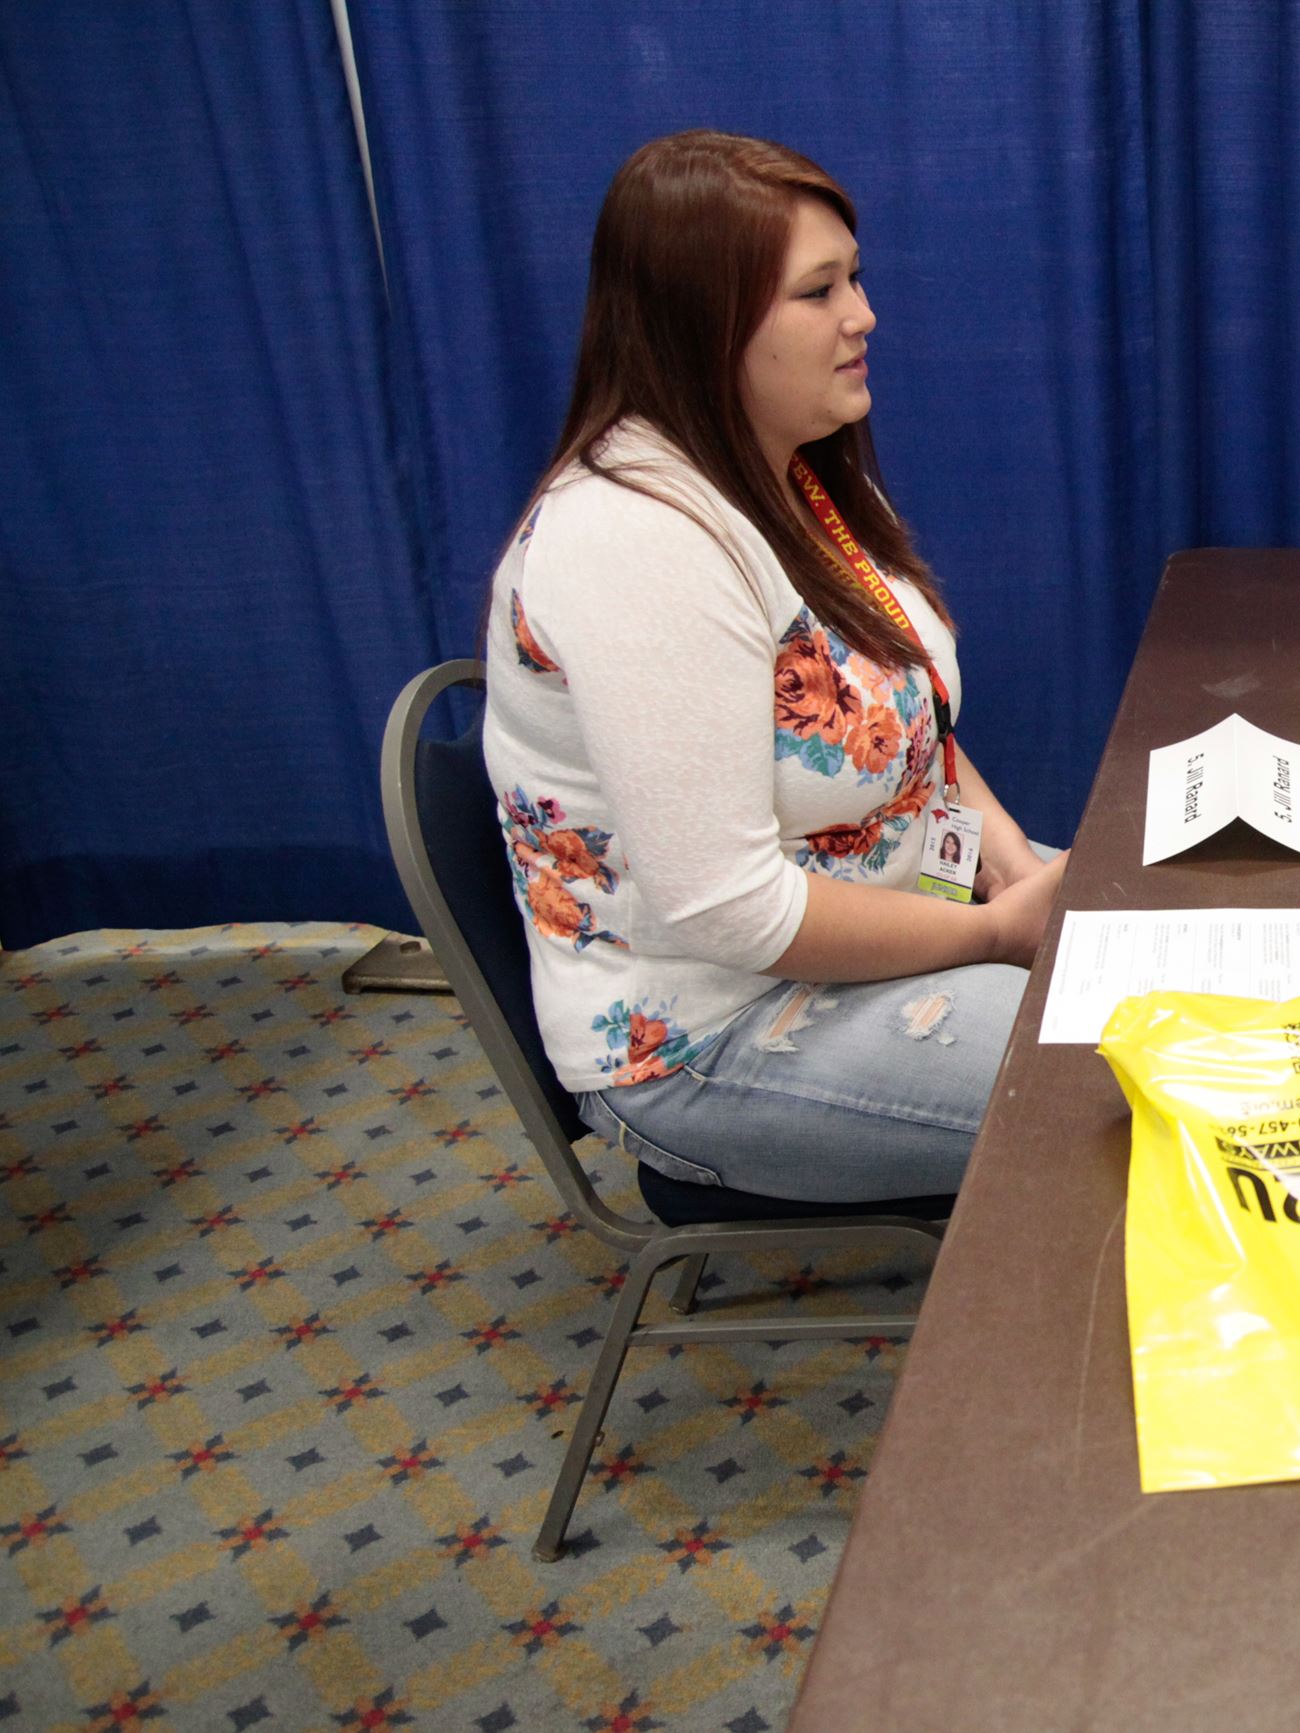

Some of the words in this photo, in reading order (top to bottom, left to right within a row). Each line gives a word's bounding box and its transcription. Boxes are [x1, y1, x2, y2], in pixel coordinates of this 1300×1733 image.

[824, 508, 859, 556] THE
[854, 559, 911, 630] PROUD
[1187, 752, 1205, 767] 5.
[1186, 766, 1204, 784] Jill
[1272, 754, 1291, 794] Ranard
[1184, 781, 1203, 824] Ranard
[1273, 790, 1292, 811] Jill
[1274, 810, 1293, 824] 5.
